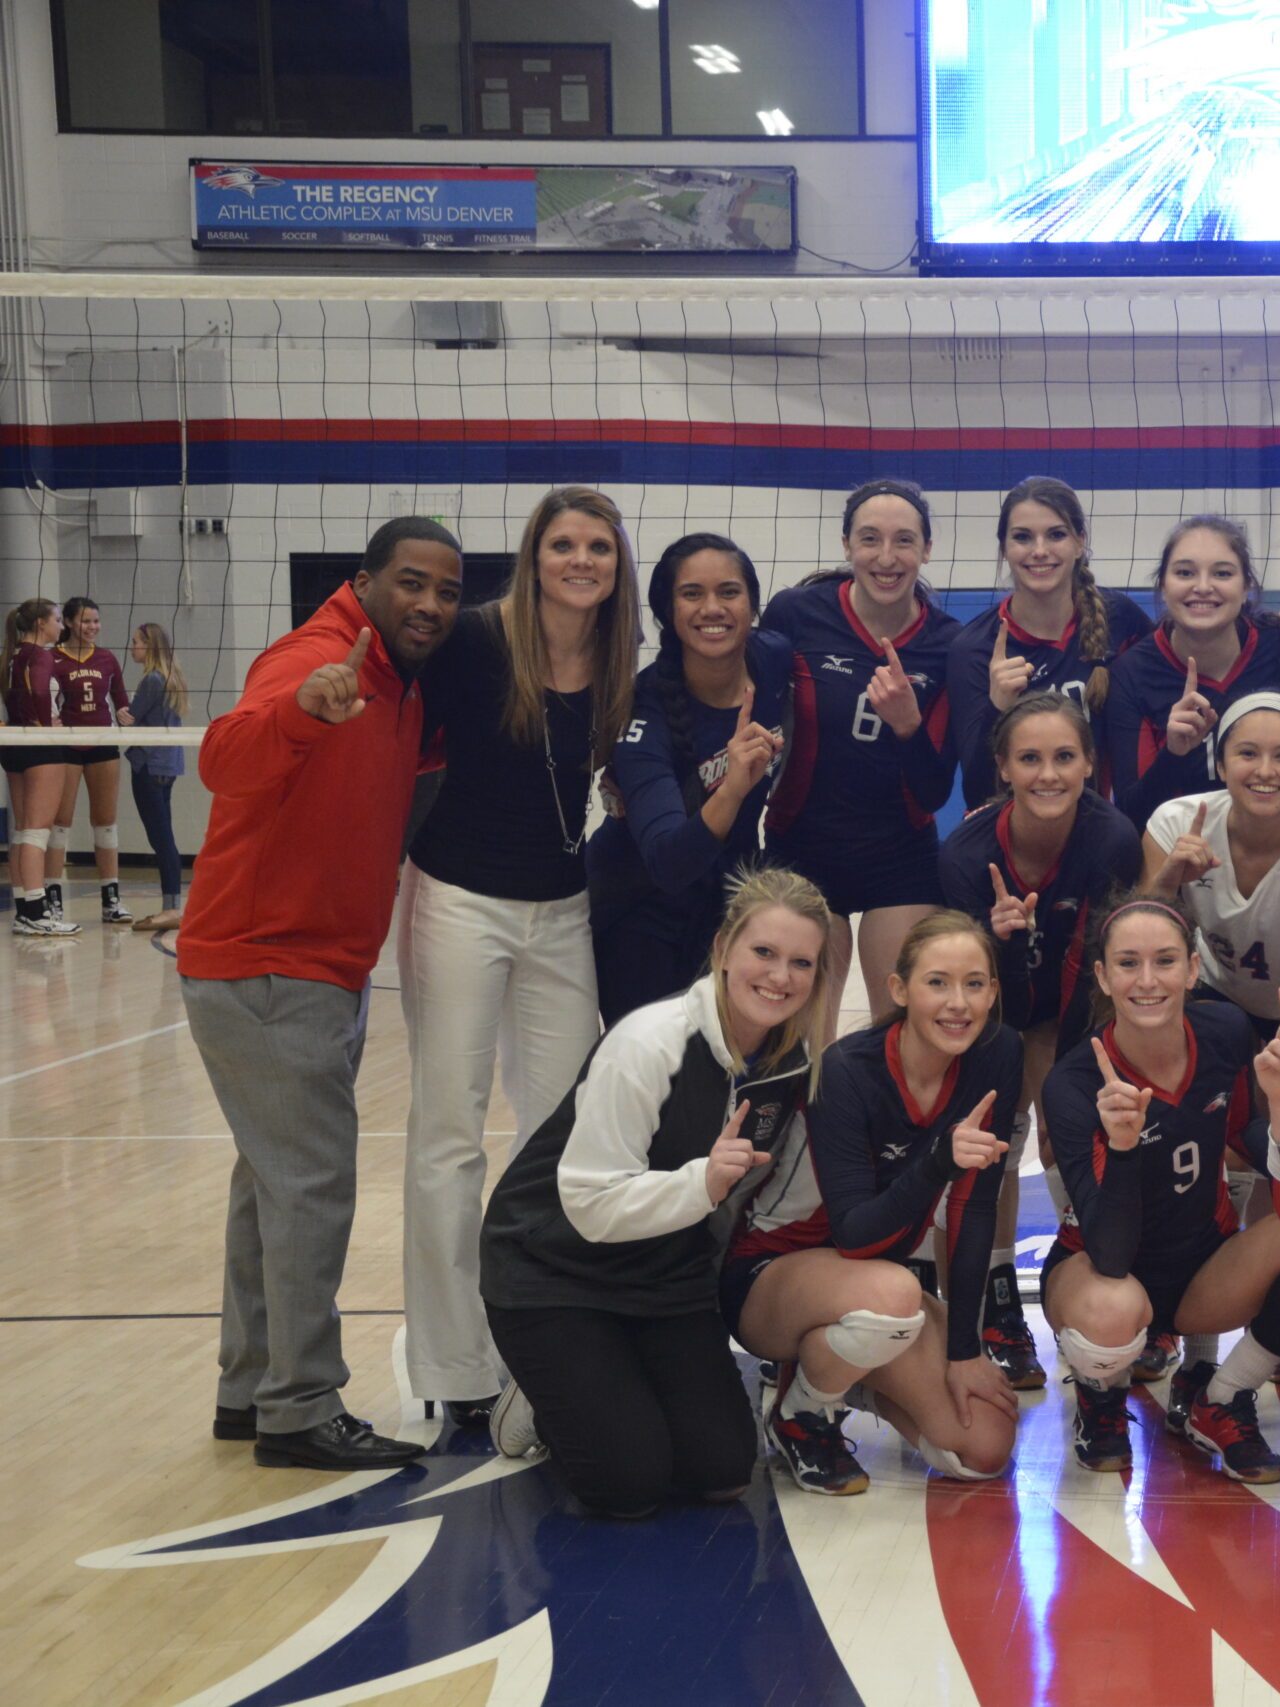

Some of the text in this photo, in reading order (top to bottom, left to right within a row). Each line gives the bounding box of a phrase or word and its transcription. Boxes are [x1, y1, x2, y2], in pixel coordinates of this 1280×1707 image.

[293, 185, 438, 203] THE REGENCY
[218, 205, 514, 222] ATHLETIC COMPLEX AT MSU DENVER
[207, 231, 249, 241] BASEBALL
[282, 232, 317, 241] SOCCER
[348, 232, 390, 242] SOFTBALL
[422, 233, 454, 243] TENNIS
[474, 234, 532, 243] FITNESS TRAIL
[83, 681, 93, 702] 5
[852, 691, 881, 742] 6
[1172, 1140, 1200, 1194] 9
